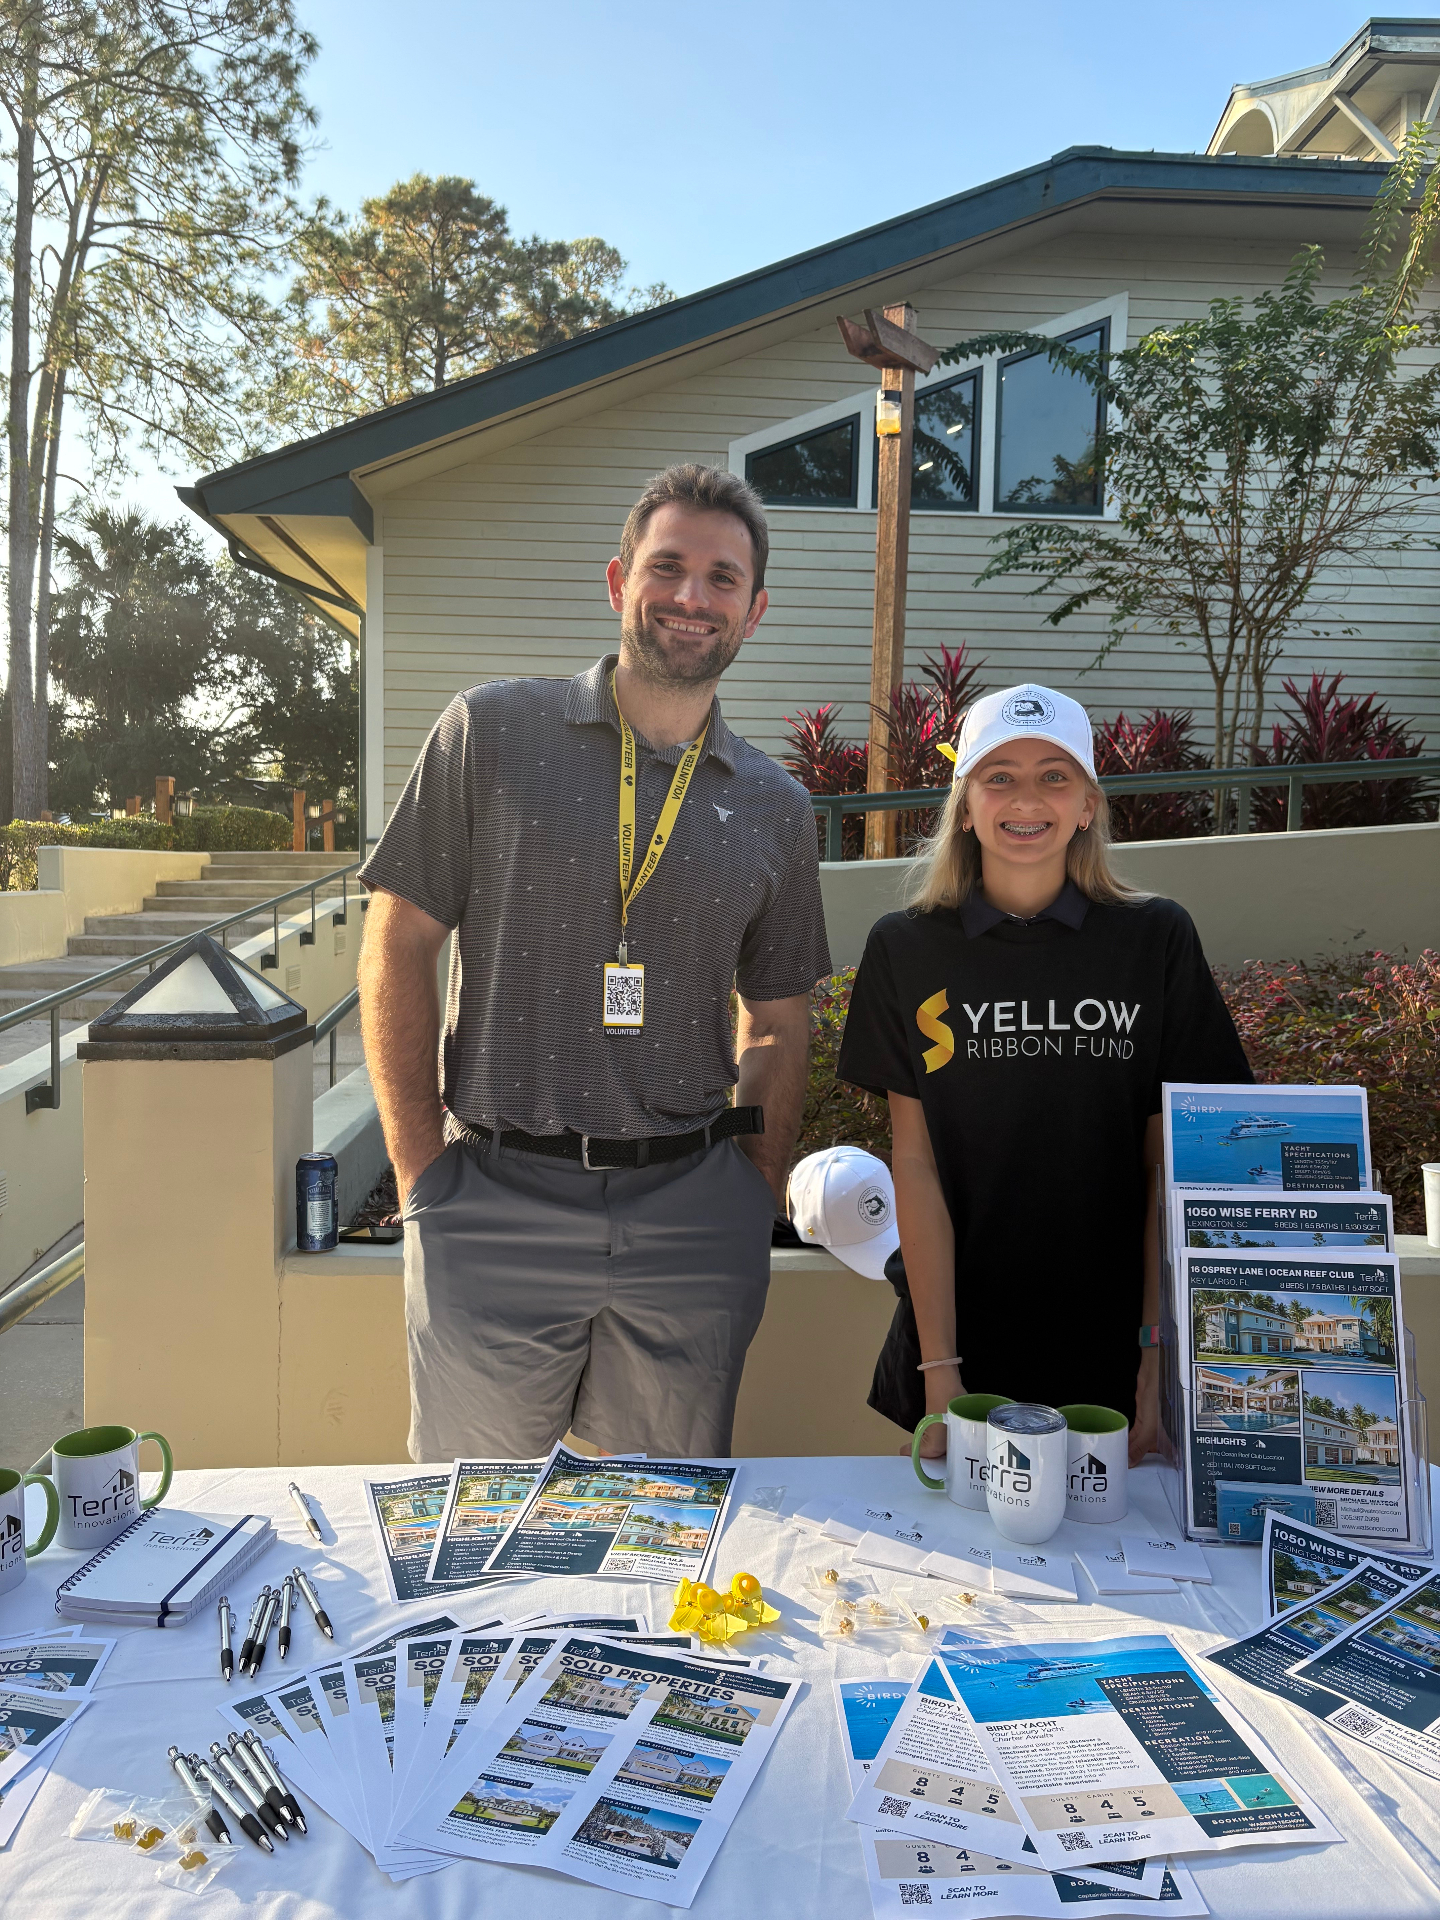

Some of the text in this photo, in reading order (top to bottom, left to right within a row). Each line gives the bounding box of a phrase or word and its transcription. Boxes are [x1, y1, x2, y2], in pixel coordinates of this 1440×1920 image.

[672, 754, 696, 801] VOLUNTEER
[622, 823, 632, 882] VOLUNTEER
[962, 999, 1141, 1034] YELLOW
[605, 1027, 641, 1036] VOLUNTEER
[967, 1036, 1135, 1060] RIBBON FUND
[1190, 1105, 1223, 1114] BIRDY
[1284, 1151, 1351, 1159] SPECIFICATIONS
[1286, 1182, 1345, 1190] DESTINATIONS
[1186, 1207, 1379, 1221] 1050 WISE FERRY RD Terra
[1190, 1265, 1385, 1283] 16 OSPREY LANE OCEAN REEF CLUB Terra
[1190, 1277, 1206, 1285] KEY
[1285, 1282, 1305, 1290] BEDS
[1321, 1283, 1346, 1291] BATHS
[1369, 1285, 1389, 1293] SQFT
[1196, 1436, 1247, 1447] HIGHLIGHTS
[567, 1459, 600, 1468] OSPREY
[1066, 1474, 1108, 1492] rra
[1066, 1493, 1107, 1504] vations
[1327, 1486, 1350, 1495] MORE
[1350, 1488, 1384, 1498] DETAILS
[67, 1487, 135, 1518] Terra
[1340, 1497, 1369, 1505] MICHAEL
[73, 1506, 136, 1530] Innovations
[151, 1531, 210, 1546] Terra
[143, 1542, 201, 1552] Innovations
[1273, 1528, 1306, 1547] 1050
[1309, 1540, 1346, 1560] WISE
[1400, 1565, 1421, 1575] RD
[1365, 1571, 1398, 1590] 1050
[1264, 1633, 1312, 1656] HIGHLIGHT
[570, 1645, 601, 1659] Terra
[1347, 1641, 1406, 1669] HIGHLIGHTS
[413, 1658, 445, 1671] SO
[462, 1655, 501, 1667] SOL
[364, 1674, 396, 1688] SO
[559, 1655, 613, 1675] SOLD
[616, 1668, 735, 1701] PROPERTIES
[1100, 1676, 1133, 1685] YACHT
[1104, 1678, 1185, 1690] SPECIFICATIONS
[867, 1692, 908, 1700] BIRDY
[920, 1697, 955, 1710] BIRDY
[1121, 1702, 1195, 1714] DESTINATIONS
[916, 1707, 947, 1719] Charter
[985, 1720, 1058, 1732] BIRDY YACHT
[990, 1726, 1065, 1738] Your Luxury Yacht
[992, 1735, 1023, 1743] Charter
[1144, 1735, 1210, 1746] RECREATION
[1385, 1728, 1419, 1746] ALLISON
[915, 1776, 1000, 1805] 8 4 5
[1063, 1796, 1147, 1814] 8 4 5
[914, 1813, 969, 1831] LEARN MORE
[923, 1809, 961, 1823] SCAN TO
[1211, 1811, 1301, 1825] BOOKING CONTACT
[1098, 1834, 1152, 1845] LEARN MORE
[916, 1850, 970, 1863] 8 4
[940, 1889, 999, 1900] LEARN MORE
[947, 1886, 971, 1894] SCAN
